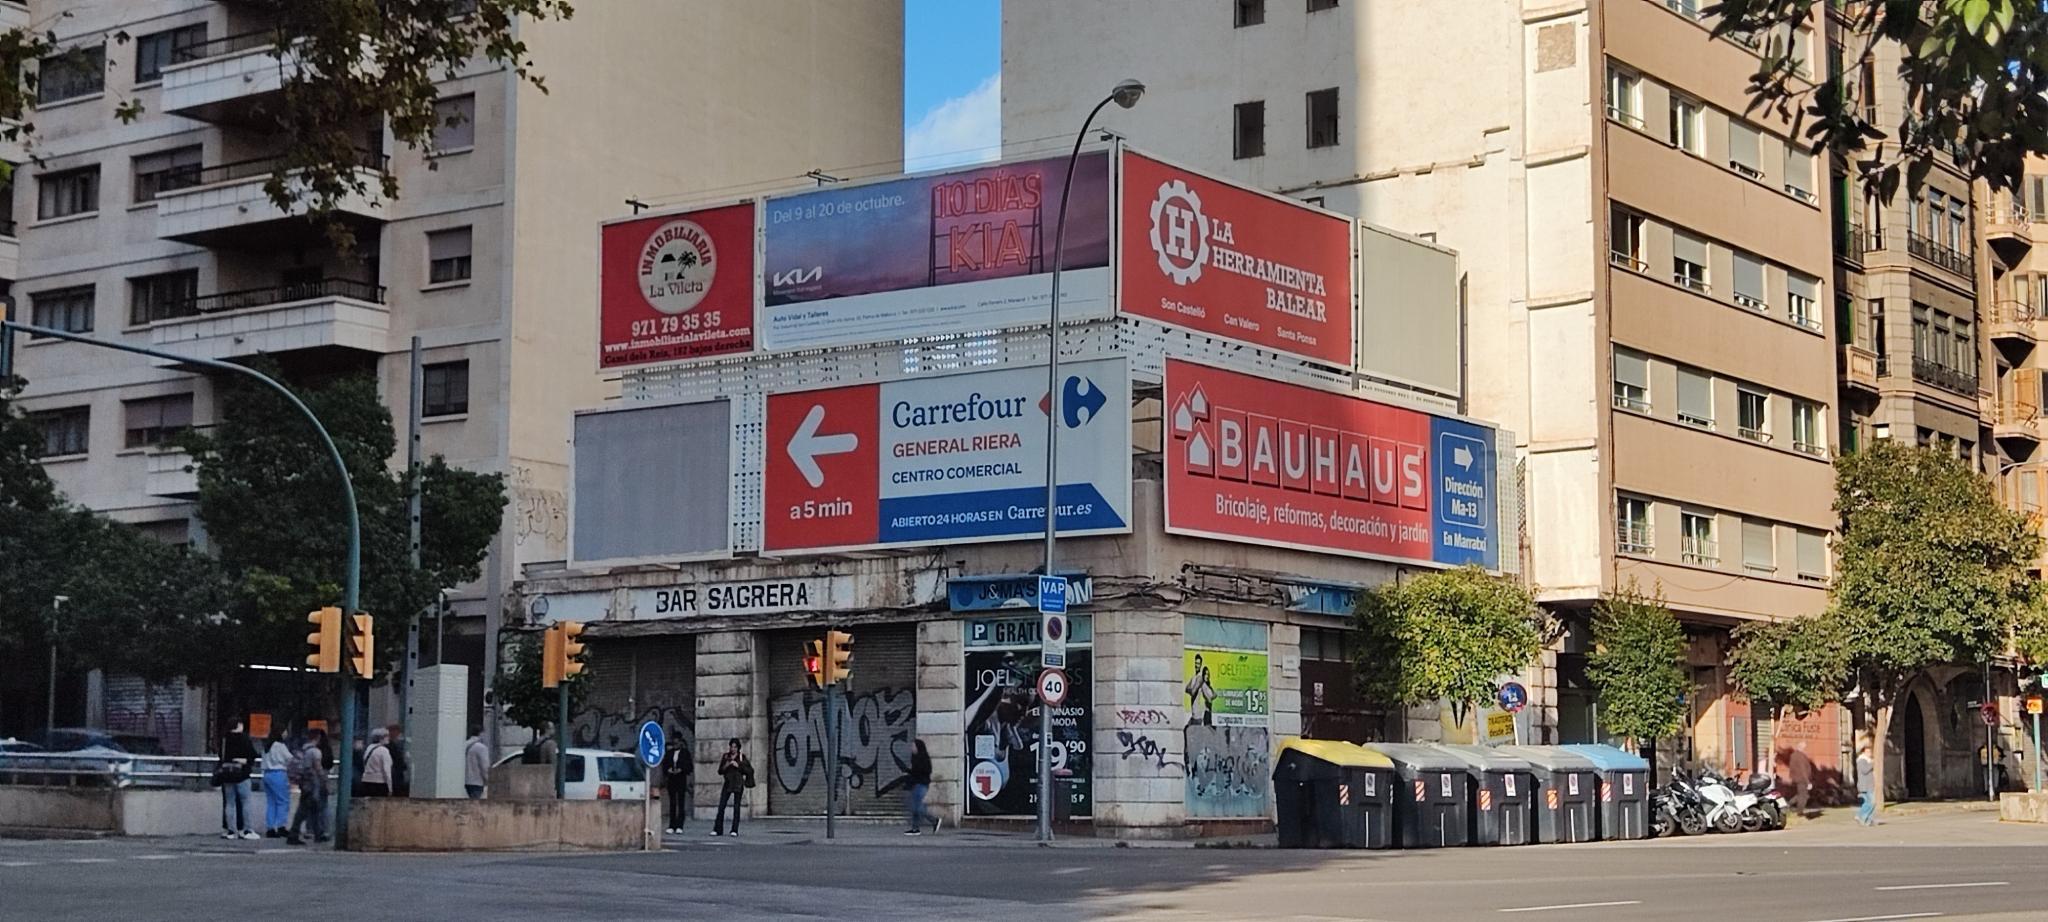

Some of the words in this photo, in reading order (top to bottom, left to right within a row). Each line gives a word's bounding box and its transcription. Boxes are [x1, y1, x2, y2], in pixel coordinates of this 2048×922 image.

[935, 180, 967, 217] 10
[974, 170, 1042, 215] DÍAS
[773, 207, 793, 225] Del
[795, 205, 803, 221] 9
[805, 204, 817, 220] al
[818, 202, 834, 218] 20
[836, 199, 852, 215] de
[854, 194, 905, 214] octubre.
[1166, 203, 1195, 261] H
[1212, 218, 1235, 246] LA
[641, 226, 712, 276] INMOBILIARIA
[950, 219, 1028, 274] KIA
[1212, 245, 1327, 297] HERRAMIENTA
[649, 285, 665, 299] La
[669, 280, 704, 297] Vileta
[1161, 297, 1176, 311] Son
[1266, 287, 1327, 323] BALEAR
[631, 319, 657, 337] 971
[660, 315, 679, 335] 79
[682, 312, 700, 331] 35
[703, 310, 721, 329] 35
[1223, 313, 1238, 326] Can
[1238, 315, 1260, 332] Valero
[604, 326, 751, 353] www.inmobiliarialavileta.com
[1276, 326, 1296, 340] Santa
[1296, 329, 1317, 347] Ponsa
[891, 392, 1027, 429] Carrefour
[892, 436, 969, 459] GENERAL
[972, 432, 1022, 452] RIERA
[1220, 419, 1424, 498] BAUHAUS
[891, 468, 945, 485] CENTRO
[946, 461, 1022, 481] COMERCIAL
[1445, 476, 1484, 500] Dirección
[789, 505, 801, 521] a
[803, 500, 816, 519] 5
[818, 497, 853, 518] min
[891, 514, 937, 529] ABIERTO
[936, 513, 950, 526] 24
[950, 511, 986, 526] HORAS
[987, 510, 1004, 523] EN
[1007, 503, 1093, 520] Carreur.es
[1215, 493, 1271, 526] Bricolaje,
[1273, 505, 1328, 533] reformas,
[1329, 509, 1389, 539] decoración
[1389, 523, 1397, 541] y
[1397, 518, 1429, 545] jardín
[1451, 497, 1478, 520] Ma-13
[1442, 530, 1454, 548] En
[656, 588, 697, 614] BAR
[707, 581, 809, 610] SAGRERA
[1042, 580, 1066, 595] VAP
[974, 624, 986, 639] P
[1044, 680, 1062, 694] 40
